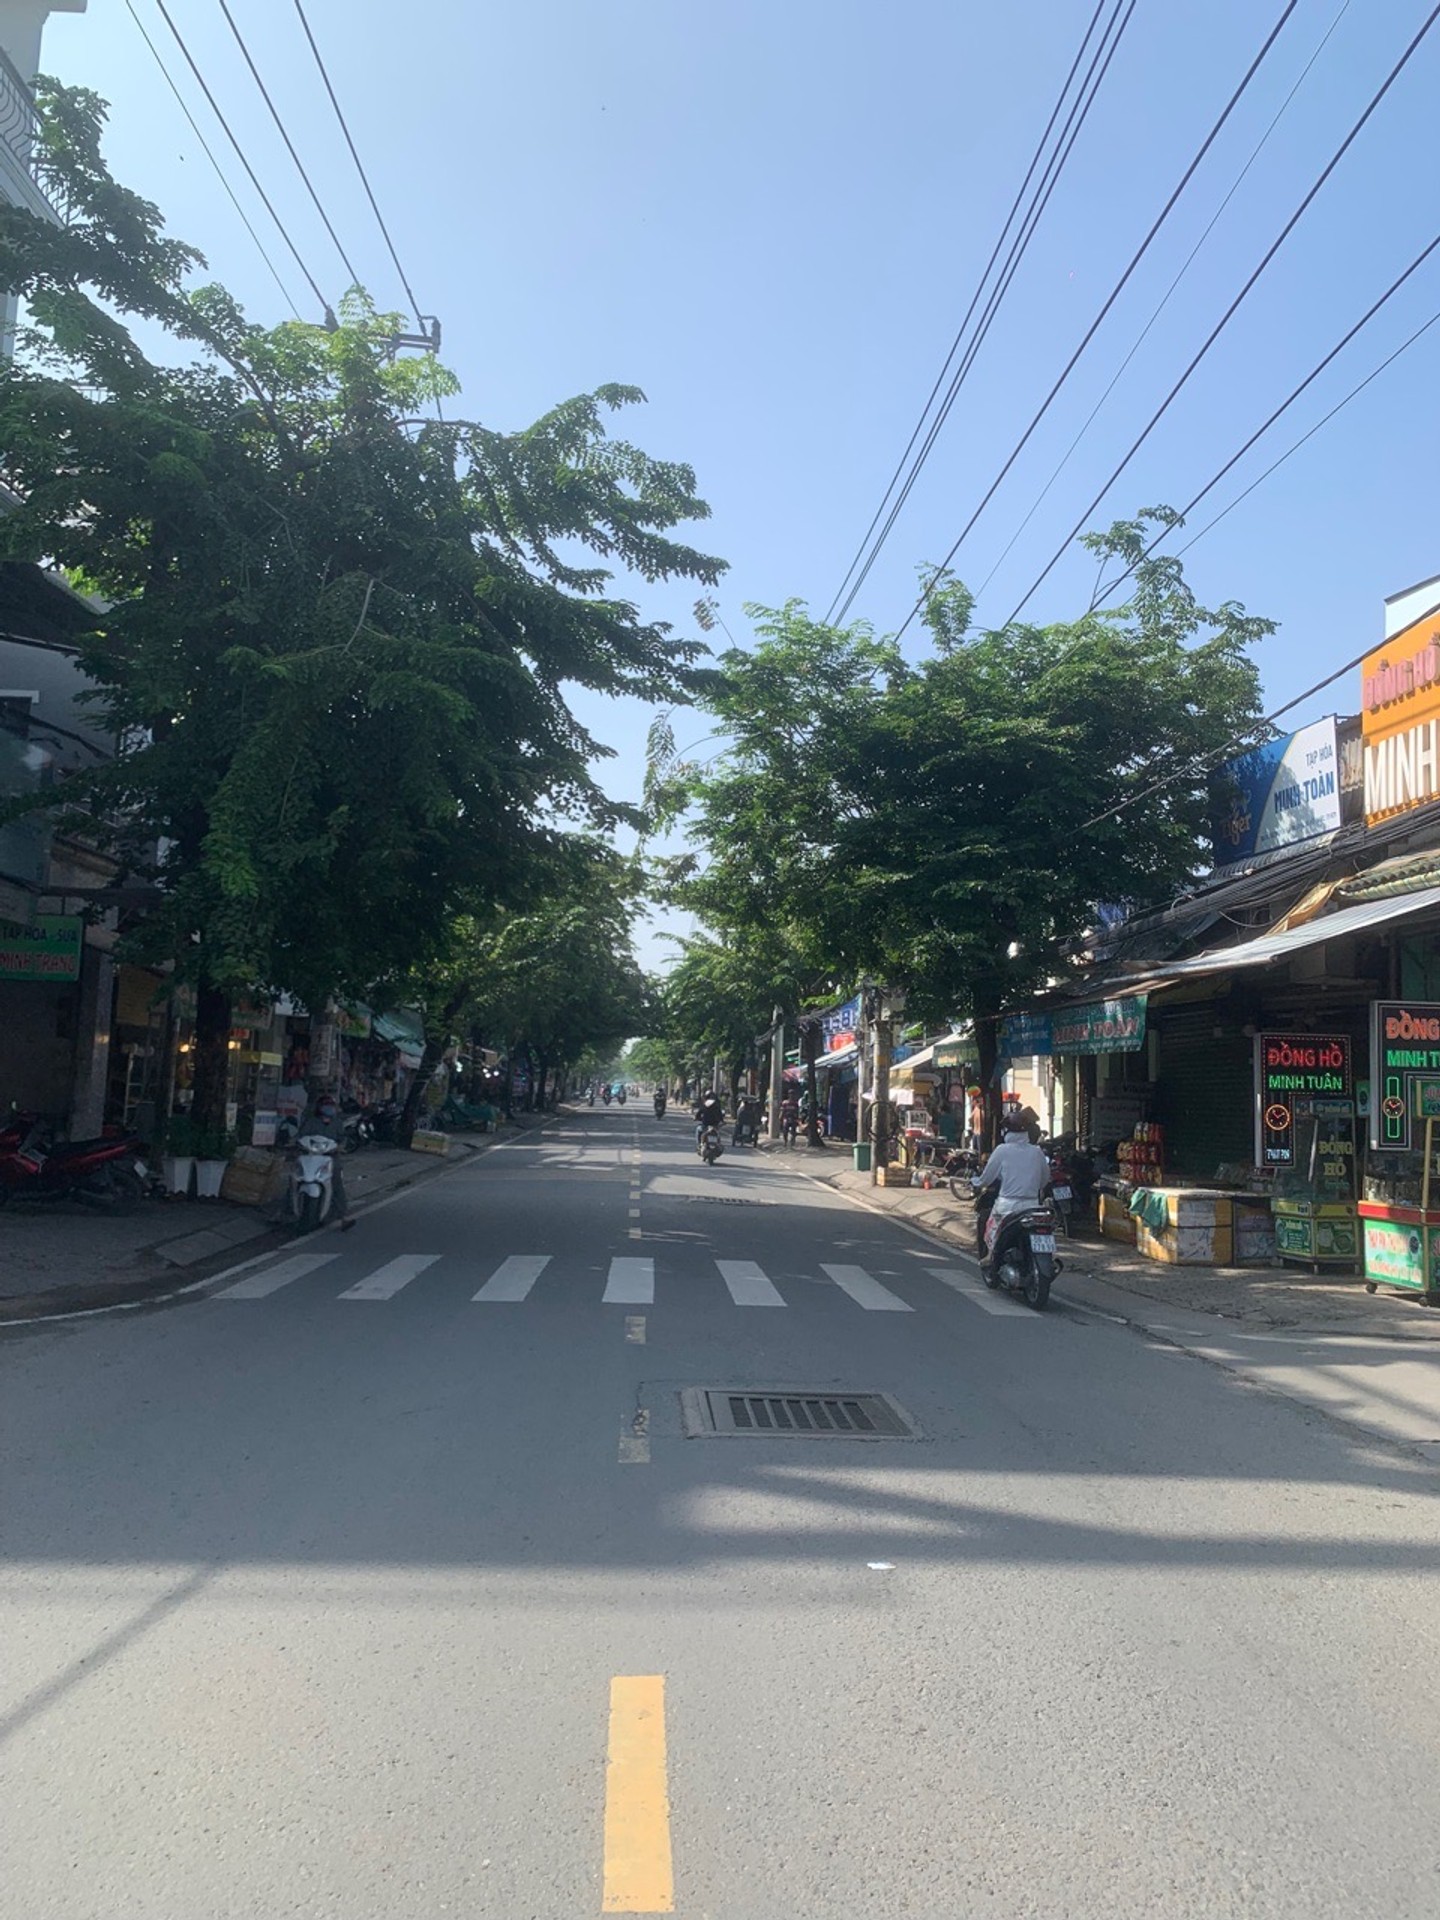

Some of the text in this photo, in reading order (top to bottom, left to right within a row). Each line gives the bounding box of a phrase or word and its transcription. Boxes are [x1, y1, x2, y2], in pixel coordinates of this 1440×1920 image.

[1364, 718, 1438, 816] MINH
[1274, 770, 1335, 814] MINH TOÀN
[1267, 1041, 1343, 1067] ĐỒNG HỒ
[1387, 1050, 1427, 1067] MINH
[1268, 1075, 1305, 1089] MINH
